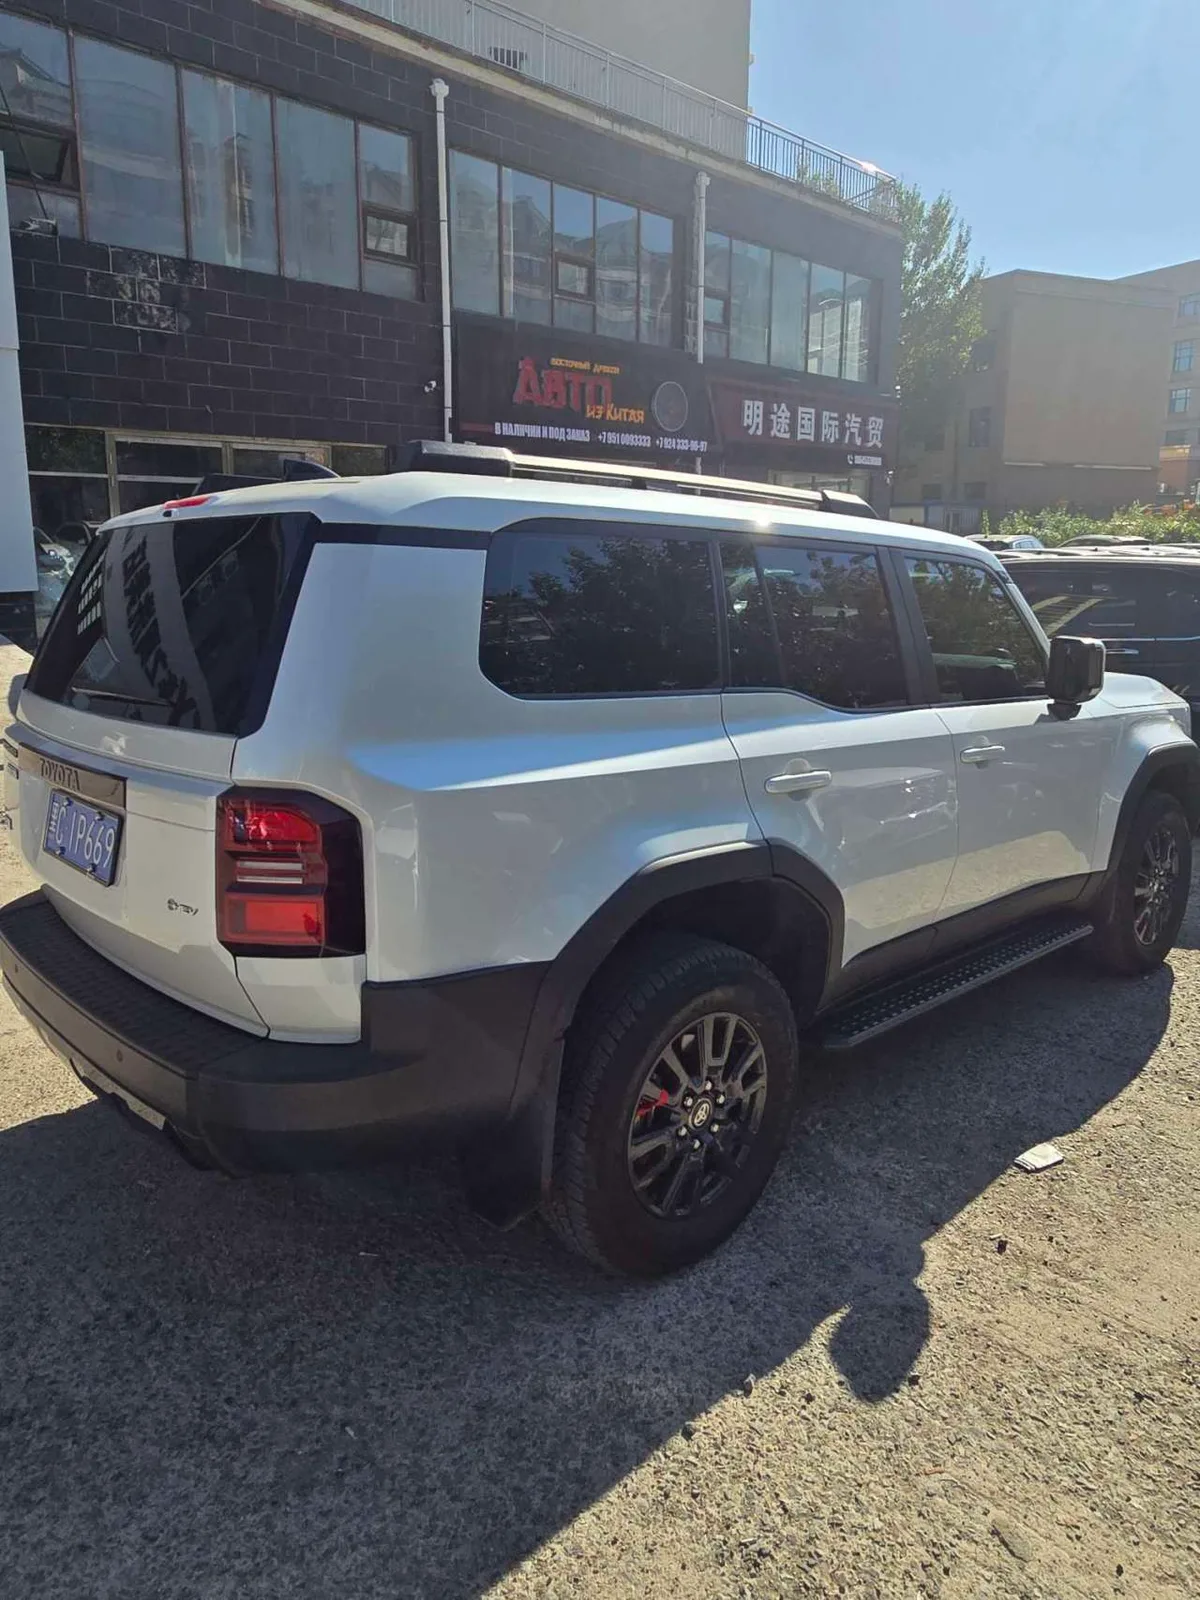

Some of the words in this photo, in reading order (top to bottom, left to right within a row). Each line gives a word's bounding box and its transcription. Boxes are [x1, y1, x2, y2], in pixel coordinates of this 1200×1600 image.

[494, 421, 501, 435] В
[502, 422, 541, 438] НАЛИЧИИ
[542, 425, 548, 439] И
[549, 426, 566, 442] ПОД
[743, 400, 884, 449] 明途国际汽贸
[40, 757, 81, 791] TOYOTA
